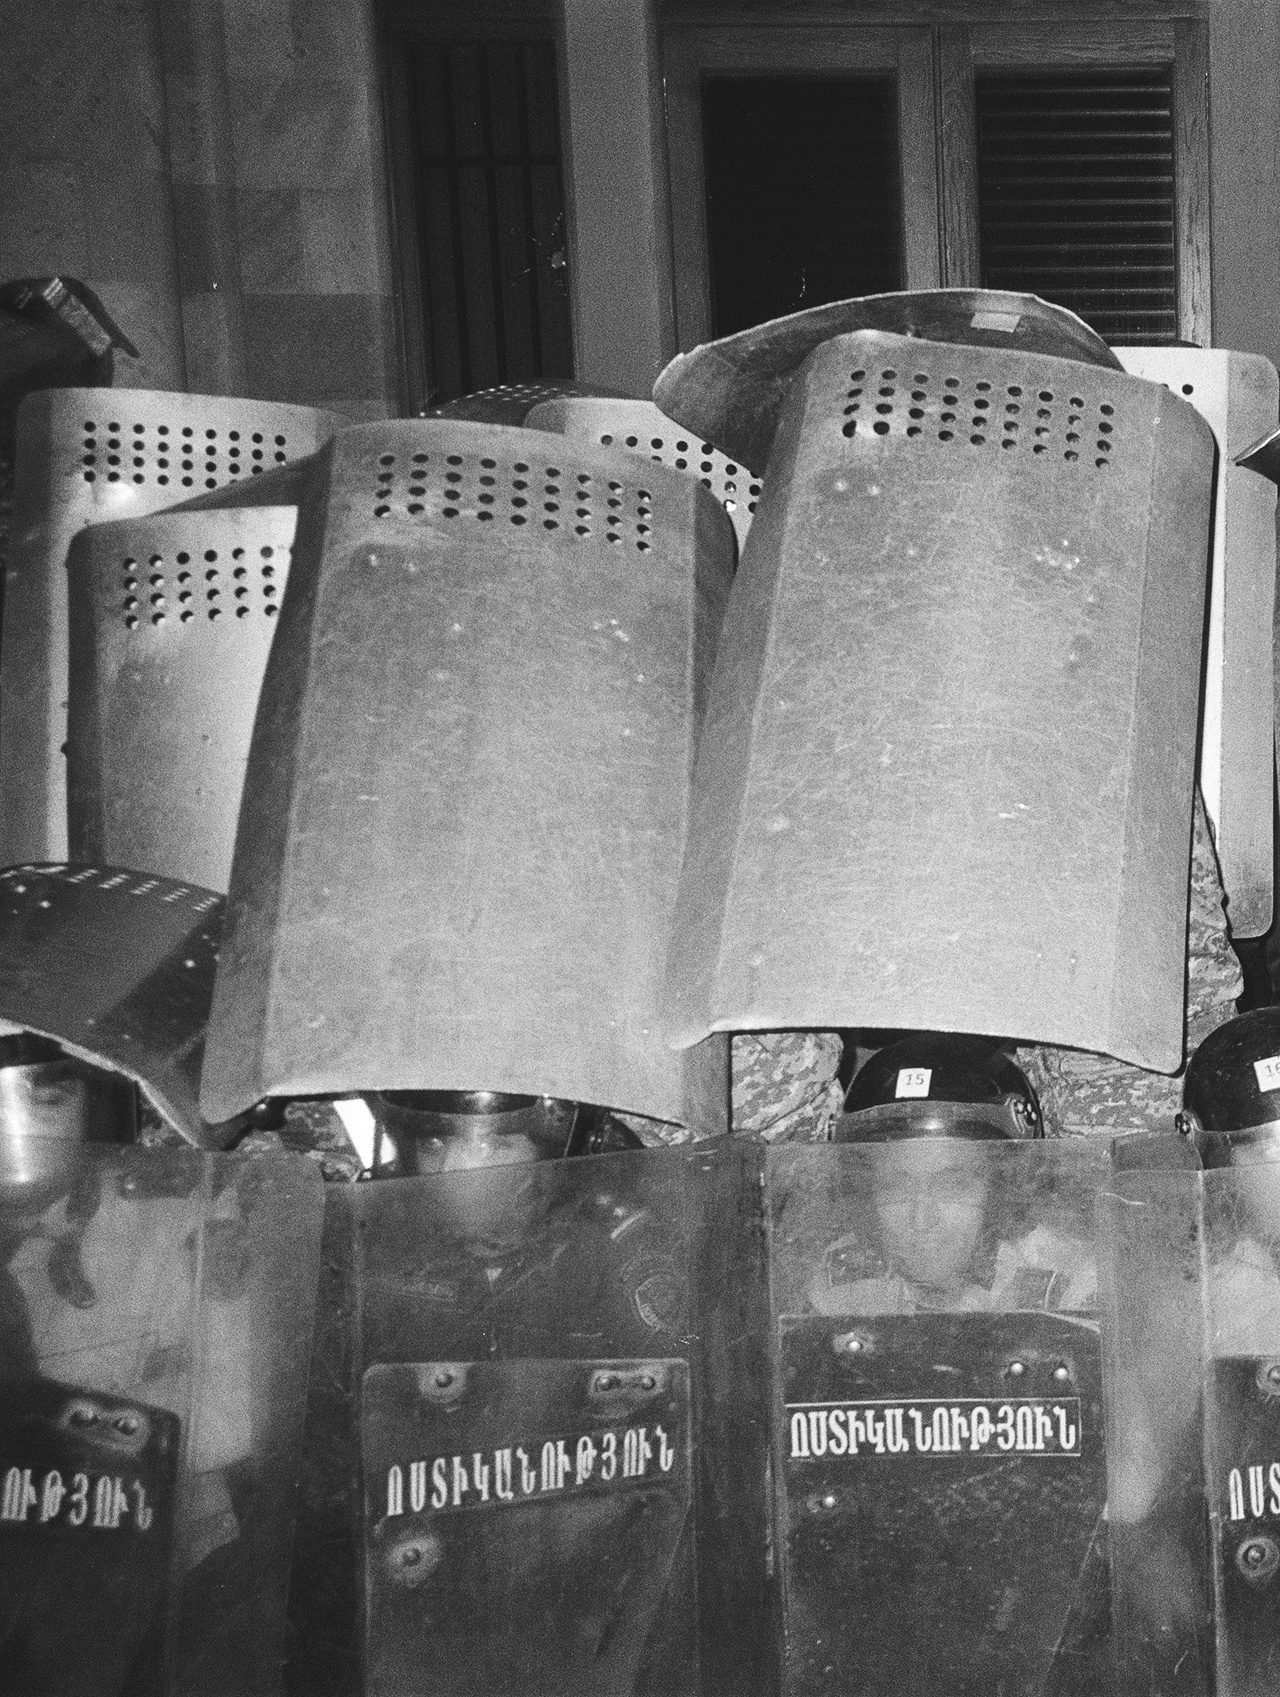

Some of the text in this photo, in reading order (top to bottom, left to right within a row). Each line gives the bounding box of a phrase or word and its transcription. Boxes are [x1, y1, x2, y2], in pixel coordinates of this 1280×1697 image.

[906, 1073, 924, 1086] 15
[789, 1405, 1076, 1458] ՈՍՏԻԿԱՆՈՒԹՅՈՒՆ
[387, 1425, 674, 1517] ՈՍՏԻԿԱՆՈՒԹՅՈՒՆ
